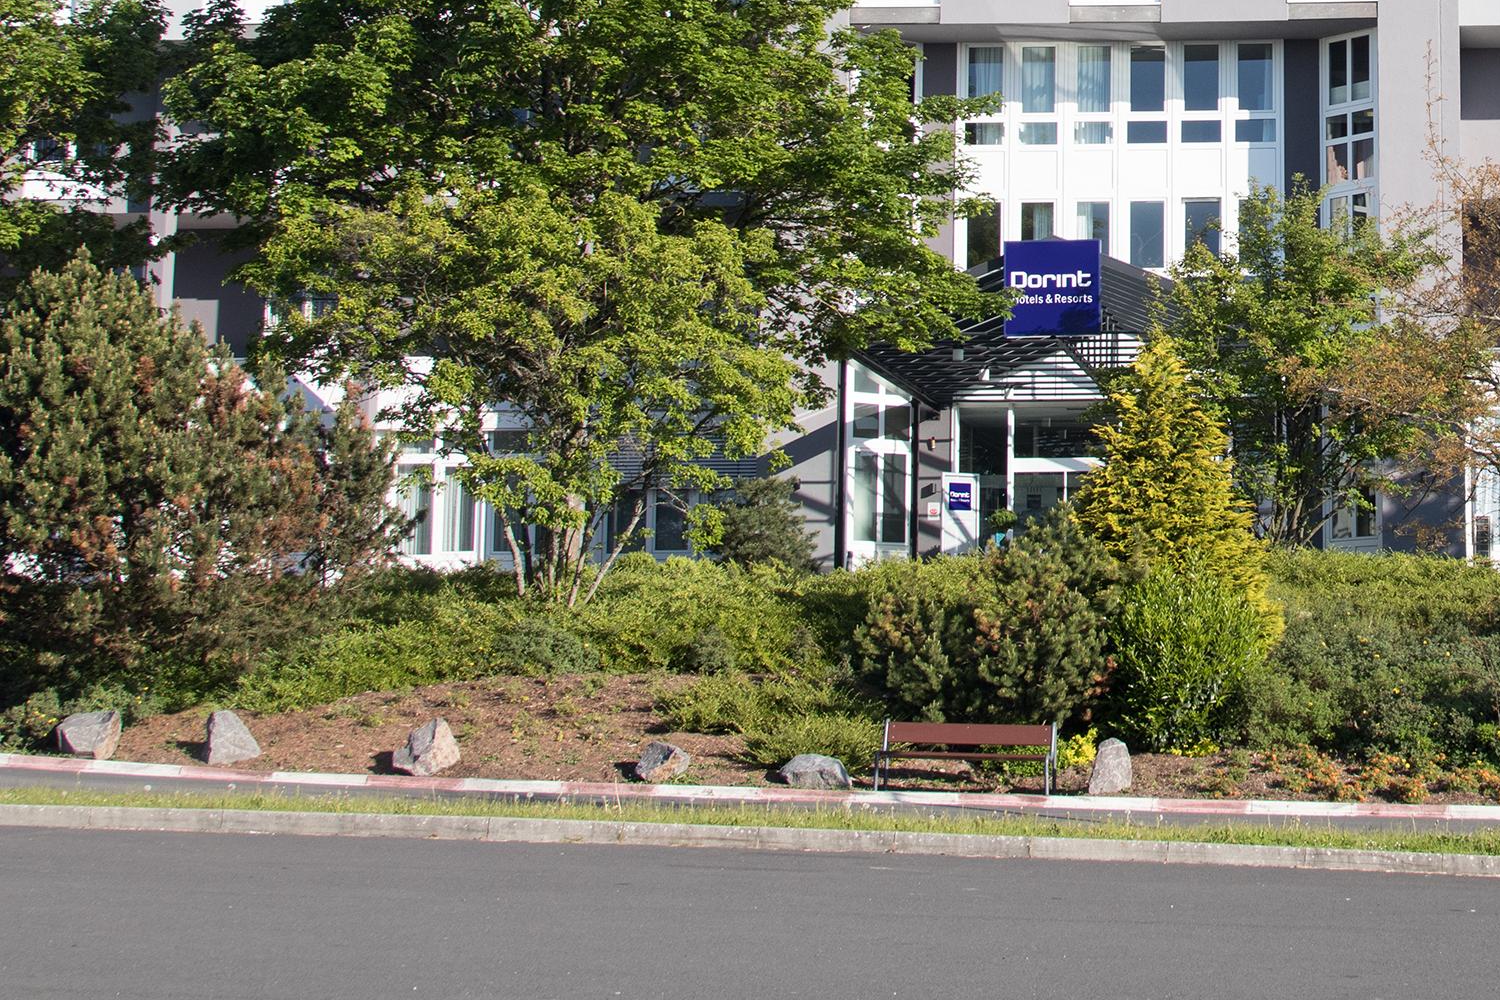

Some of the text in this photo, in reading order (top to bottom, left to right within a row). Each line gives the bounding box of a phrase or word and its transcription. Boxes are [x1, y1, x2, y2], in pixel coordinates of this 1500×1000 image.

[1010, 270, 1092, 289] Dorint
[1045, 293, 1053, 304] &
[1054, 293, 1093, 304] Resorts
